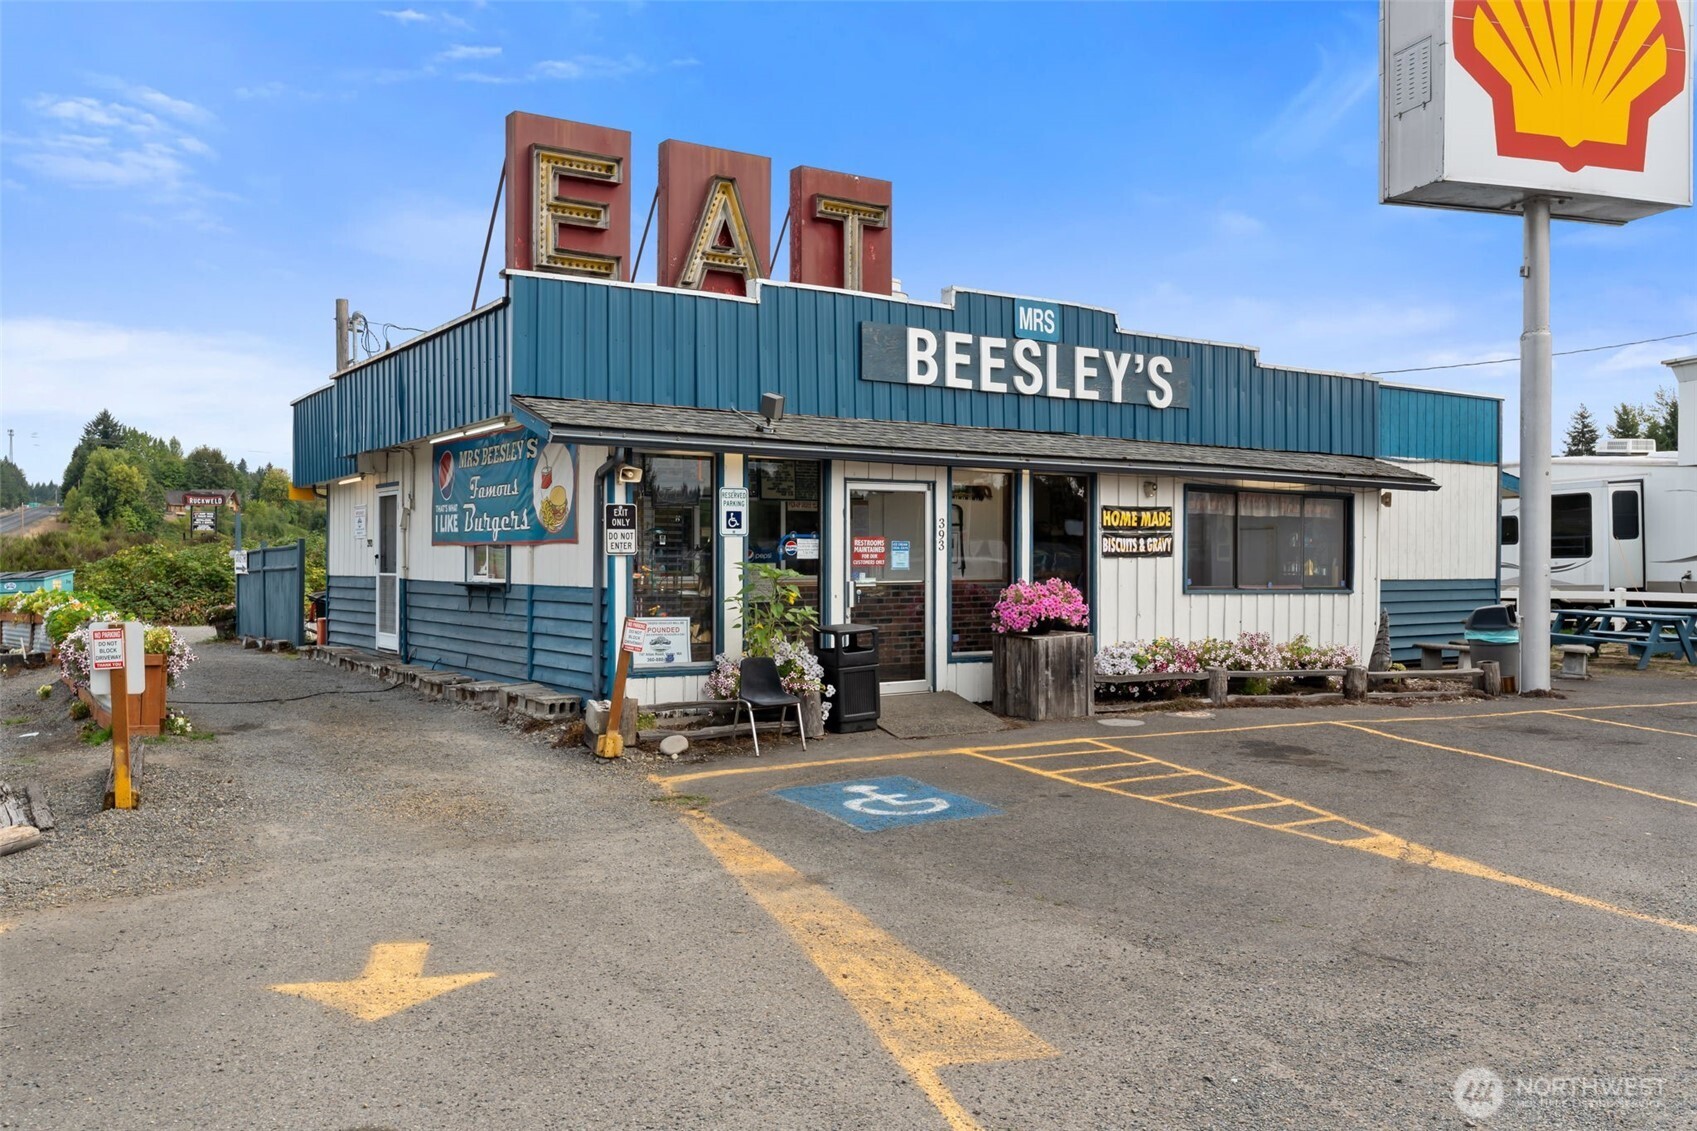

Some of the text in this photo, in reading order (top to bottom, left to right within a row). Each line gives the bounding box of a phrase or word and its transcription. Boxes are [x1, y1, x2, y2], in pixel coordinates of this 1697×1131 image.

[529, 143, 889, 291] EAT
[1019, 306, 1055, 334] MRS
[906, 327, 1173, 409] BEESLEY'S
[459, 449, 480, 468] MRS
[470, 475, 519, 499] Famous
[722, 491, 747, 499] RESERVED
[613, 508, 629, 517] EXIT
[1103, 510, 1172, 527] HOME MADE
[440, 514, 459, 532] LIKE
[463, 503, 531, 541] Burgers
[611, 518, 631, 527] ONLY
[608, 532, 634, 540] DO NOT
[854, 539, 885, 547] RESTROOMS
[610, 541, 633, 550] ENTER
[1102, 537, 1172, 554] BISCUITS & GRAVY
